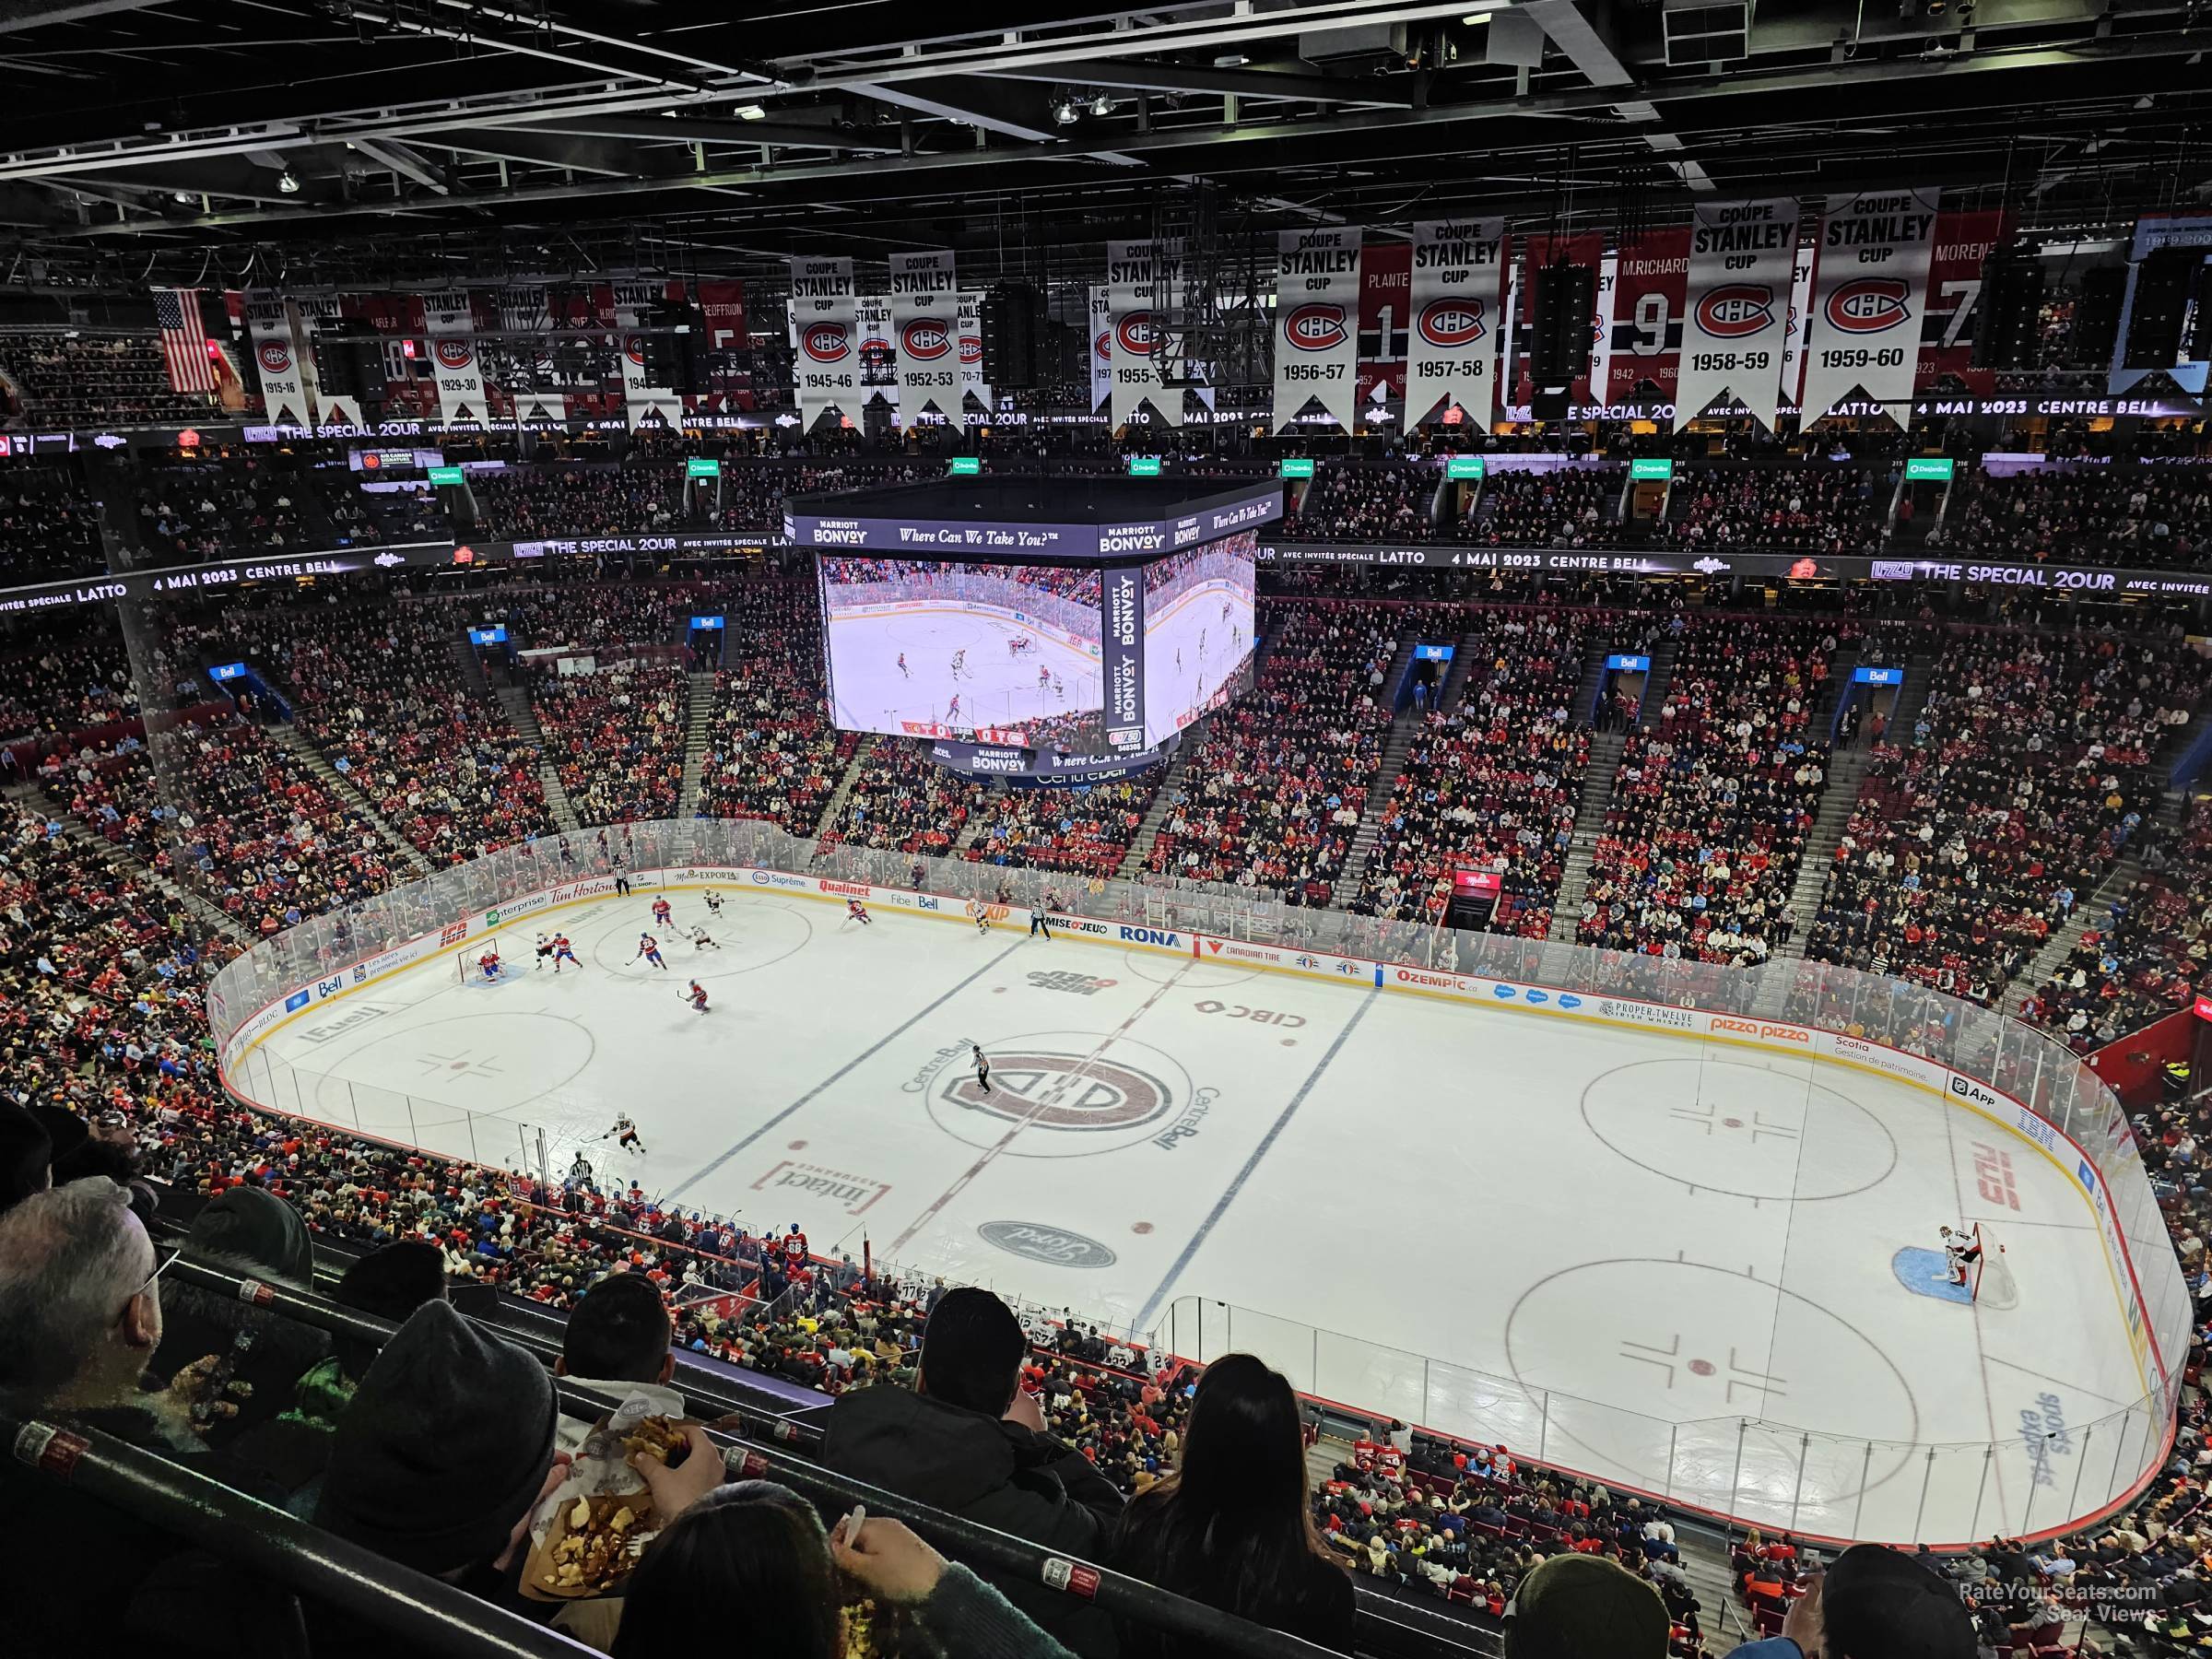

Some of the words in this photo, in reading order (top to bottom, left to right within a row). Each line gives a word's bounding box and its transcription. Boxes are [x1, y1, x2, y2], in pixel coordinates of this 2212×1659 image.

[1853, 195, 1911, 213] COUPE
[1720, 205, 1773, 222] COUPE
[1435, 223, 1481, 239] COUPE
[1695, 222, 1794, 254] STANLEY
[1827, 214, 1933, 245] STANLEY
[1300, 233, 1341, 248] COUPE
[1281, 249, 1359, 275] STANLEY
[1416, 240, 1499, 268] STANLEY
[1724, 254, 1758, 270] CUP
[1858, 248, 1894, 264] CUP
[806, 263, 838, 275] COUPE
[906, 257, 939, 270] COUPE
[1622, 258, 1689, 276] M.RICHARD
[893, 271, 953, 294] STANLEY
[1306, 277, 1331, 290] CUP
[1369, 273, 1409, 288] PLANTE
[1441, 270, 1469, 284] CUP
[795, 276, 852, 298] STANLEY
[298, 300, 339, 318] STANLEY
[424, 293, 468, 313] STANLEY
[702, 302, 742, 317] GEOFFRION
[815, 300, 833, 311] CUP
[914, 295, 934, 307] CUP
[247, 300, 285, 321] STANLEY
[440, 314, 456, 324] CUP
[1940, 280, 1982, 348] 7
[1630, 292, 1669, 357] 9
[1373, 305, 1397, 363] 1
[1691, 352, 1770, 371] 1958-59
[1821, 348, 1903, 368] 1959-60
[1283, 364, 1346, 381] 1956-57
[1417, 360, 1483, 378] 1957-58
[1613, 368, 1633, 381] 1942
[441, 379, 477, 392] 1929-30
[806, 373, 853, 388] 1945-46
[904, 371, 954, 386] 1952-53
[265, 382, 296, 394] 1915-16
[1582, 405, 1649, 420] SPECIAL
[1707, 406, 1732, 416] AVEC
[1828, 399, 1884, 417] LATTO
[1916, 401, 1928, 415] 4
[1936, 399, 1972, 415] MAI
[1982, 400, 2027, 415] 2023
[2038, 399, 2109, 416] CENTRE
[2116, 400, 2162, 416] BELL
[284, 425, 314, 441] THE
[318, 423, 373, 439] SPECIAL
[600, 419, 625, 429] MAI
[819, 520, 858, 530] MARRIOTT
[1108, 525, 1156, 536] MARRIOTT
[814, 528, 867, 545] BONVOY
[900, 527, 935, 542] Where
[938, 529, 962, 544] Can
[965, 529, 982, 545] We
[986, 530, 1015, 546] Take
[1100, 535, 1166, 552] BONVOY
[1174, 525, 1201, 546] BONVOY
[552, 541, 576, 555] THE
[581, 539, 636, 554] SPECIAL
[683, 539, 702, 547] AVEC
[1283, 551, 1302, 559] AVEC
[1304, 551, 1335, 560] INVITÉE
[1336, 551, 1374, 561] SPÉCIALE
[1380, 551, 1425, 564] LATTO
[1452, 553, 1460, 565] 4
[1467, 553, 1497, 566] MAI
[1503, 554, 1541, 567] 2023
[1549, 555, 1608, 570] CENTRE
[1613, 558, 1649, 570] BELL
[76, 583, 127, 603] LATTO
[154, 579, 162, 591] 4
[168, 573, 197, 589] MAI
[201, 569, 238, 585] 2023
[246, 561, 302, 579] CENTRE
[306, 560, 338, 573] BELL
[1923, 563, 1962, 581] THE
[1968, 566, 2047, 587] SPECIAL
[2126, 580, 2158, 592] AVEC
[2162, 582, 2210, 595] INVITÉE
[1112, 587, 1122, 638] MARRIOTT
[1121, 575, 1135, 646] BONVOY
[700, 618, 714, 628] Bell
[480, 632, 495, 642] Bell
[1427, 648, 1442, 658] Bell
[1619, 656, 1637, 668] Bell
[1869, 671, 1888, 682] Bell
[1114, 665, 1123, 714] MARRIOTT
[1123, 654, 1135, 723] BONVOY
[978, 749, 1019, 759] MARRIOTT
[972, 757, 1026, 771] BONVOY
[771, 874, 806, 888] Suprême
[818, 879, 871, 897] Qualinet
[551, 888, 572, 904] Tim
[891, 894, 911, 906] Fibe
[919, 896, 938, 911] Bell
[488, 894, 547, 925] enterprise
[440, 923, 467, 948] IGA
[1120, 925, 1182, 948] RONA
[399, 955, 409, 966] vie
[1226, 947, 1264, 959] CANADIAN
[1264, 951, 1281, 962] TIRE
[368, 958, 382, 969] Les
[319, 975, 343, 998] Bell
[1227, 1005, 1307, 1029] CIBC
[1615, 1011, 1645, 1022] IRISH
[1648, 1016, 1693, 1029] WHISKEY
[1616, 1003, 1653, 1017] PROPER
[1654, 1008, 1693, 1022] TWELVE
[1711, 1018, 1758, 1034] pizza
[1760, 1024, 1809, 1043] pizza
[1835, 1036, 1869, 1053] Scotia
[1834, 1047, 1868, 1063] Gestion
[1868, 1053, 1880, 1065] de
[1880, 1060, 1927, 1082] patrimoine
[2017, 1108, 2057, 1152] IBM
[774, 1171, 871, 1208] intact
[1002, 1227, 1091, 1262] Ford
[902, 1286, 916, 1298] 77
[1154, 1355, 1161, 1369] 2
